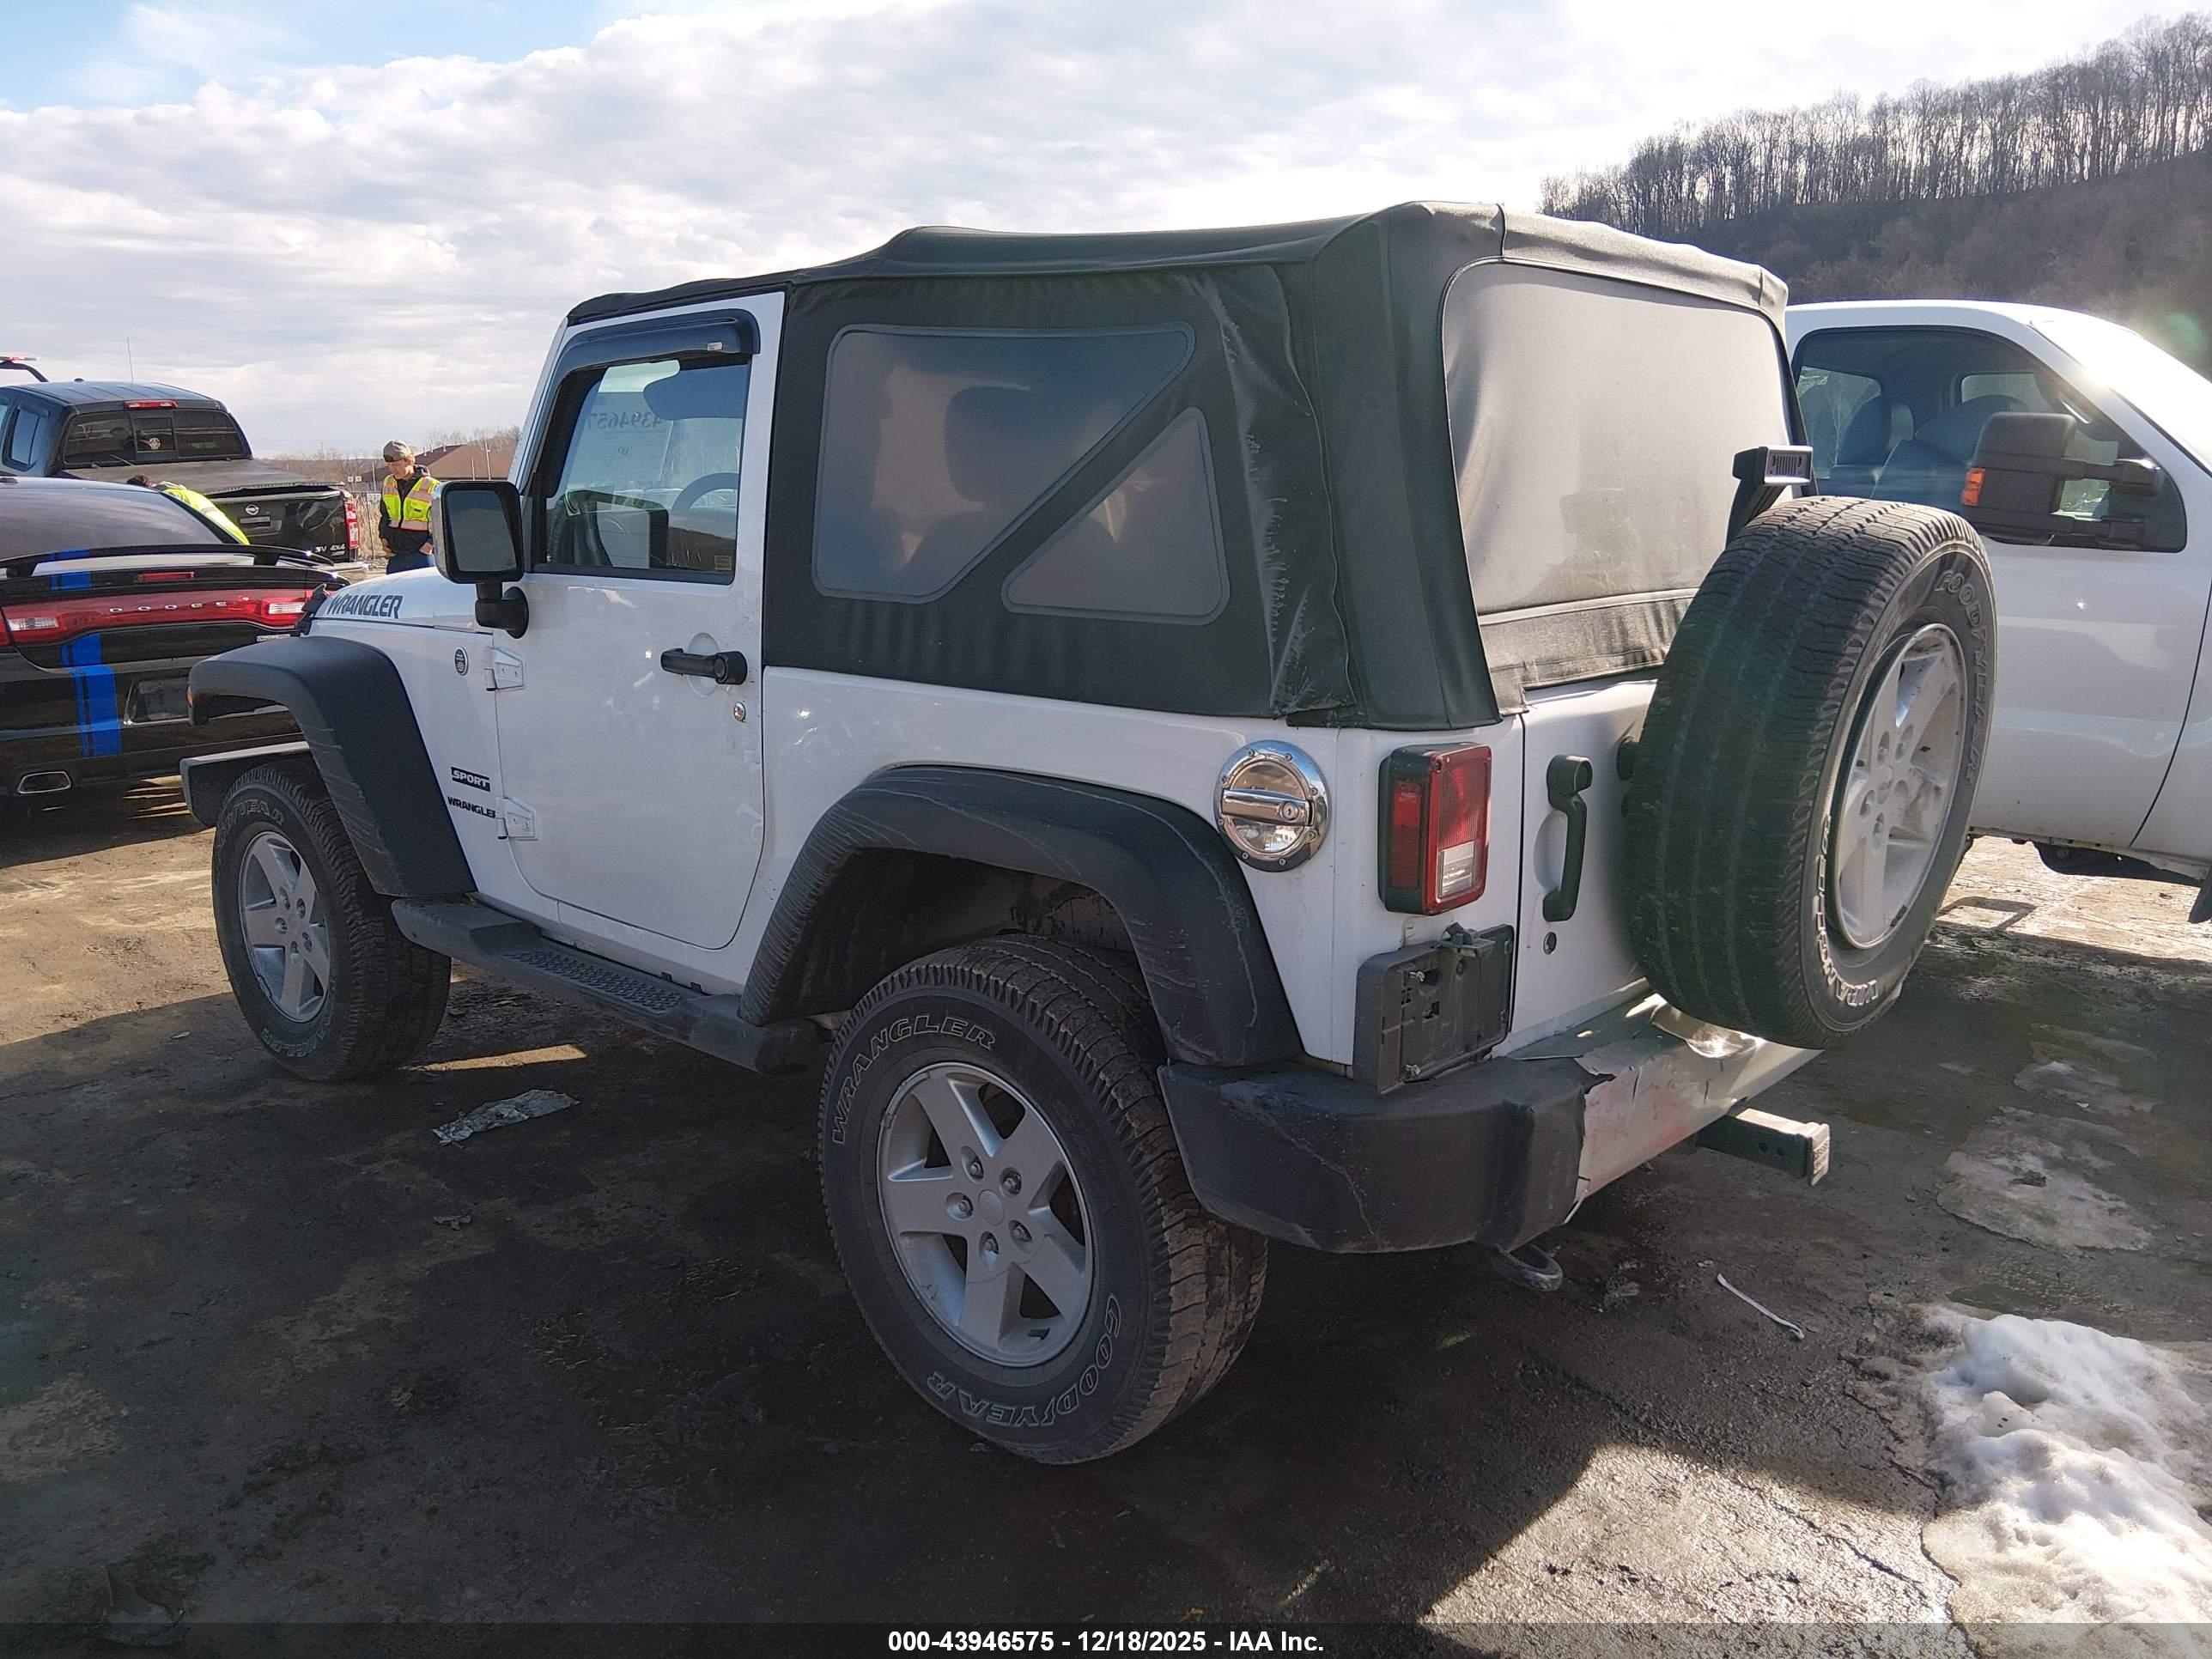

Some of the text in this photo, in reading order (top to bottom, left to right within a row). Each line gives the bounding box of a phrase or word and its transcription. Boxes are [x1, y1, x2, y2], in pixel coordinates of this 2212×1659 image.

[109, 601, 228, 613] DODGE
[327, 594, 404, 619] WRANGLER
[453, 769, 490, 787] SPORT
[832, 1015, 995, 1145] WRANGLER
[927, 1294, 1121, 1427] GOODYEAR
